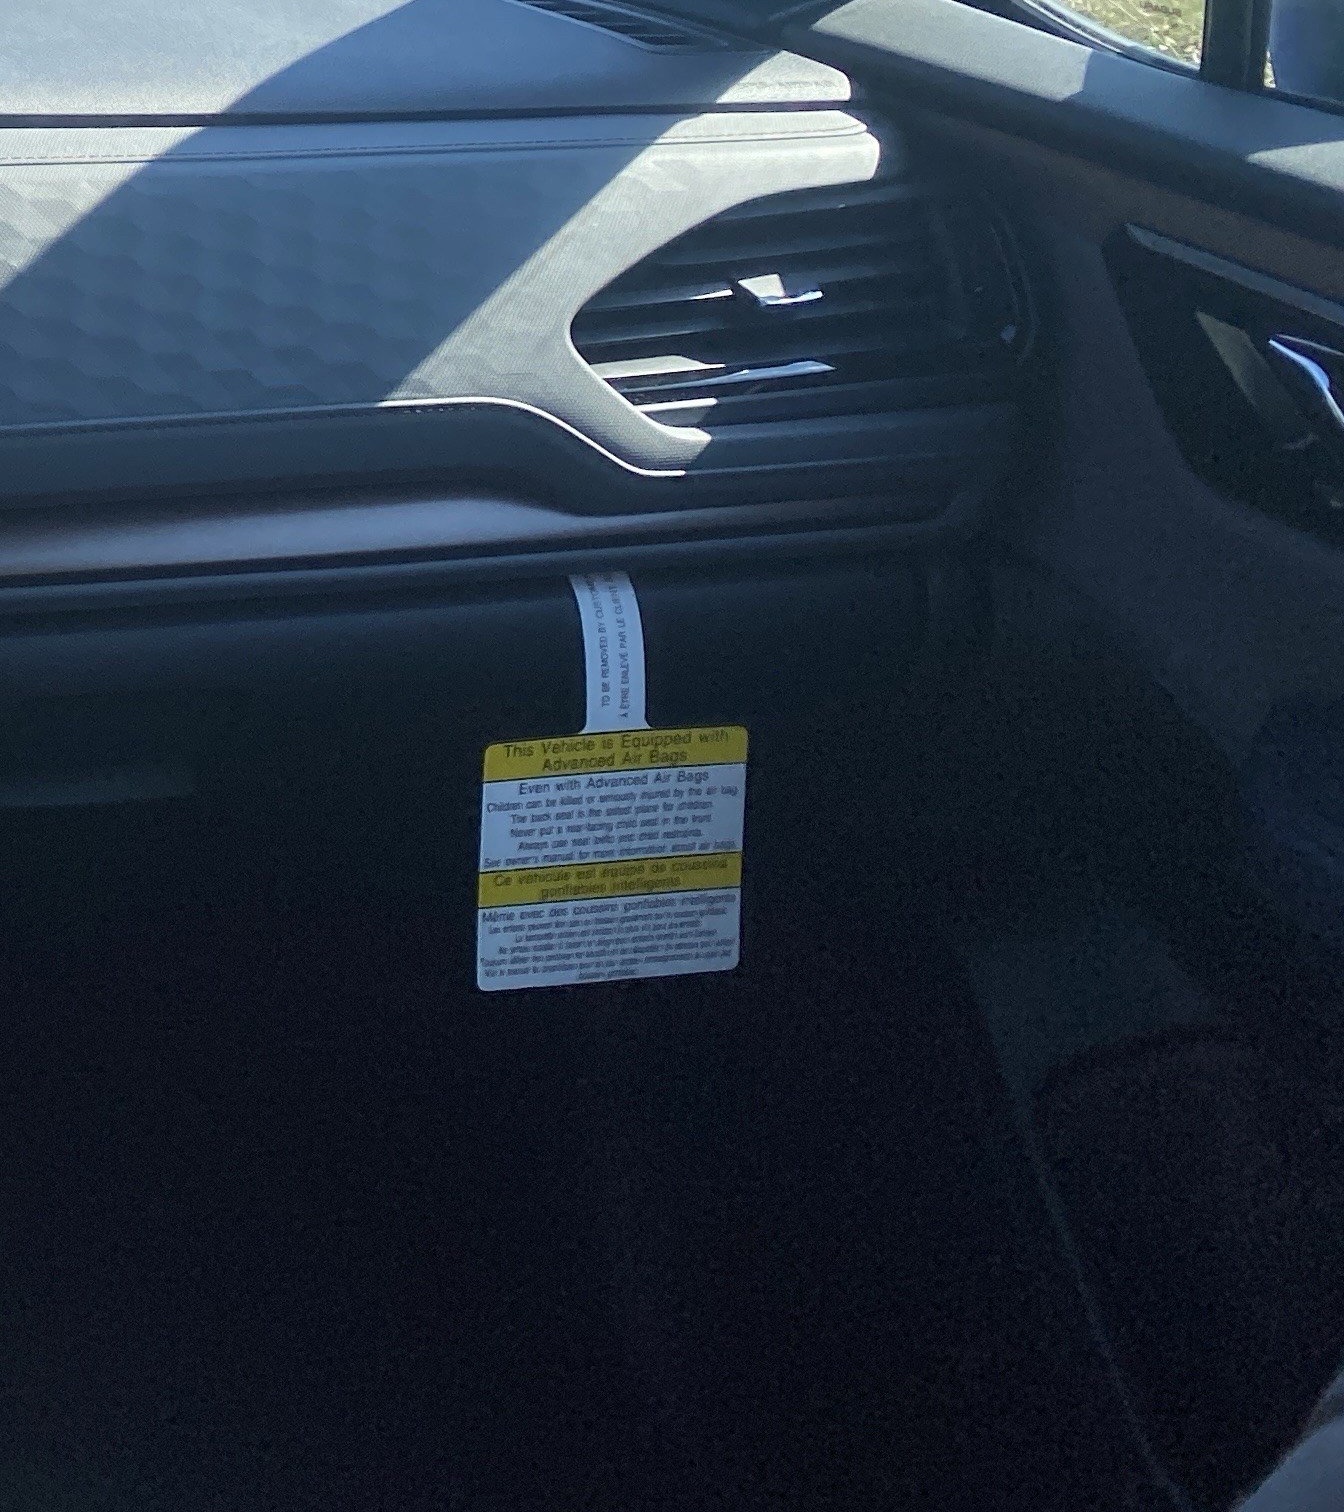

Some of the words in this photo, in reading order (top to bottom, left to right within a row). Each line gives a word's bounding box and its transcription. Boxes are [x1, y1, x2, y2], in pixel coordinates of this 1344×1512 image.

[615, 616, 625, 628] LE
[616, 629, 627, 648] PAR
[599, 634, 610, 678] REMOVED
[601, 694, 610, 707] TO
[505, 744, 533, 759] This
[541, 740, 593, 755] Vehicle
[601, 738, 613, 749] is
[621, 732, 692, 750] Equipped
[699, 729, 730, 744] with
[542, 753, 615, 772] Advanced
[622, 750, 641, 765] Air
[648, 748, 688, 766] Bags
[518, 780, 551, 797] Even
[555, 778, 581, 792] with
[586, 774, 649, 791] Advanced
[653, 770, 672, 785] Air
[677, 769, 710, 785] Bags
